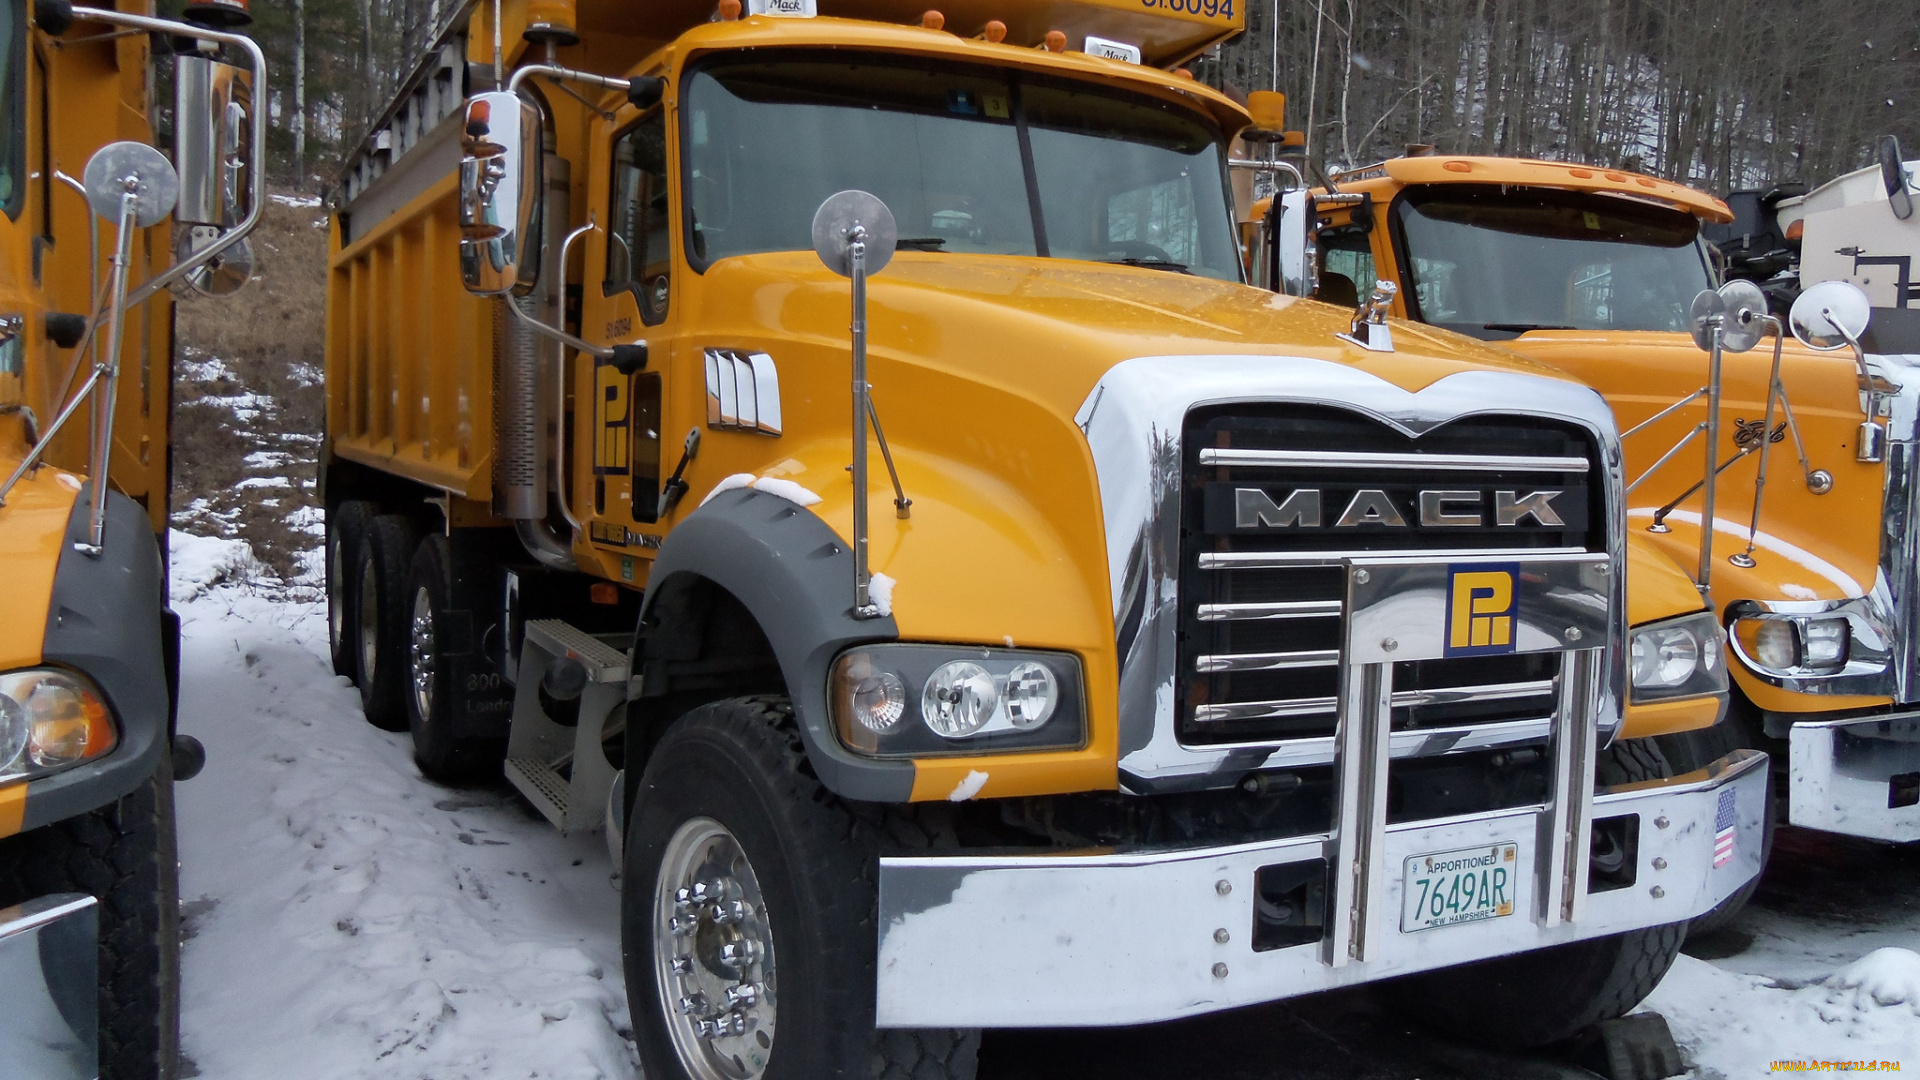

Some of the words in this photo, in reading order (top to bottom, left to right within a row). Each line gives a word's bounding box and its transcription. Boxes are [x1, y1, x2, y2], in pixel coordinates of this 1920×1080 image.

[769, 0, 802, 10] Mack
[1235, 488, 1566, 527] MACK
[1427, 854, 1497, 875] APPORTIONED
[1415, 867, 1507, 921] 7649AR
[1430, 917, 1446, 926] NEW
[1449, 910, 1490, 922] HAMPSHIRE
